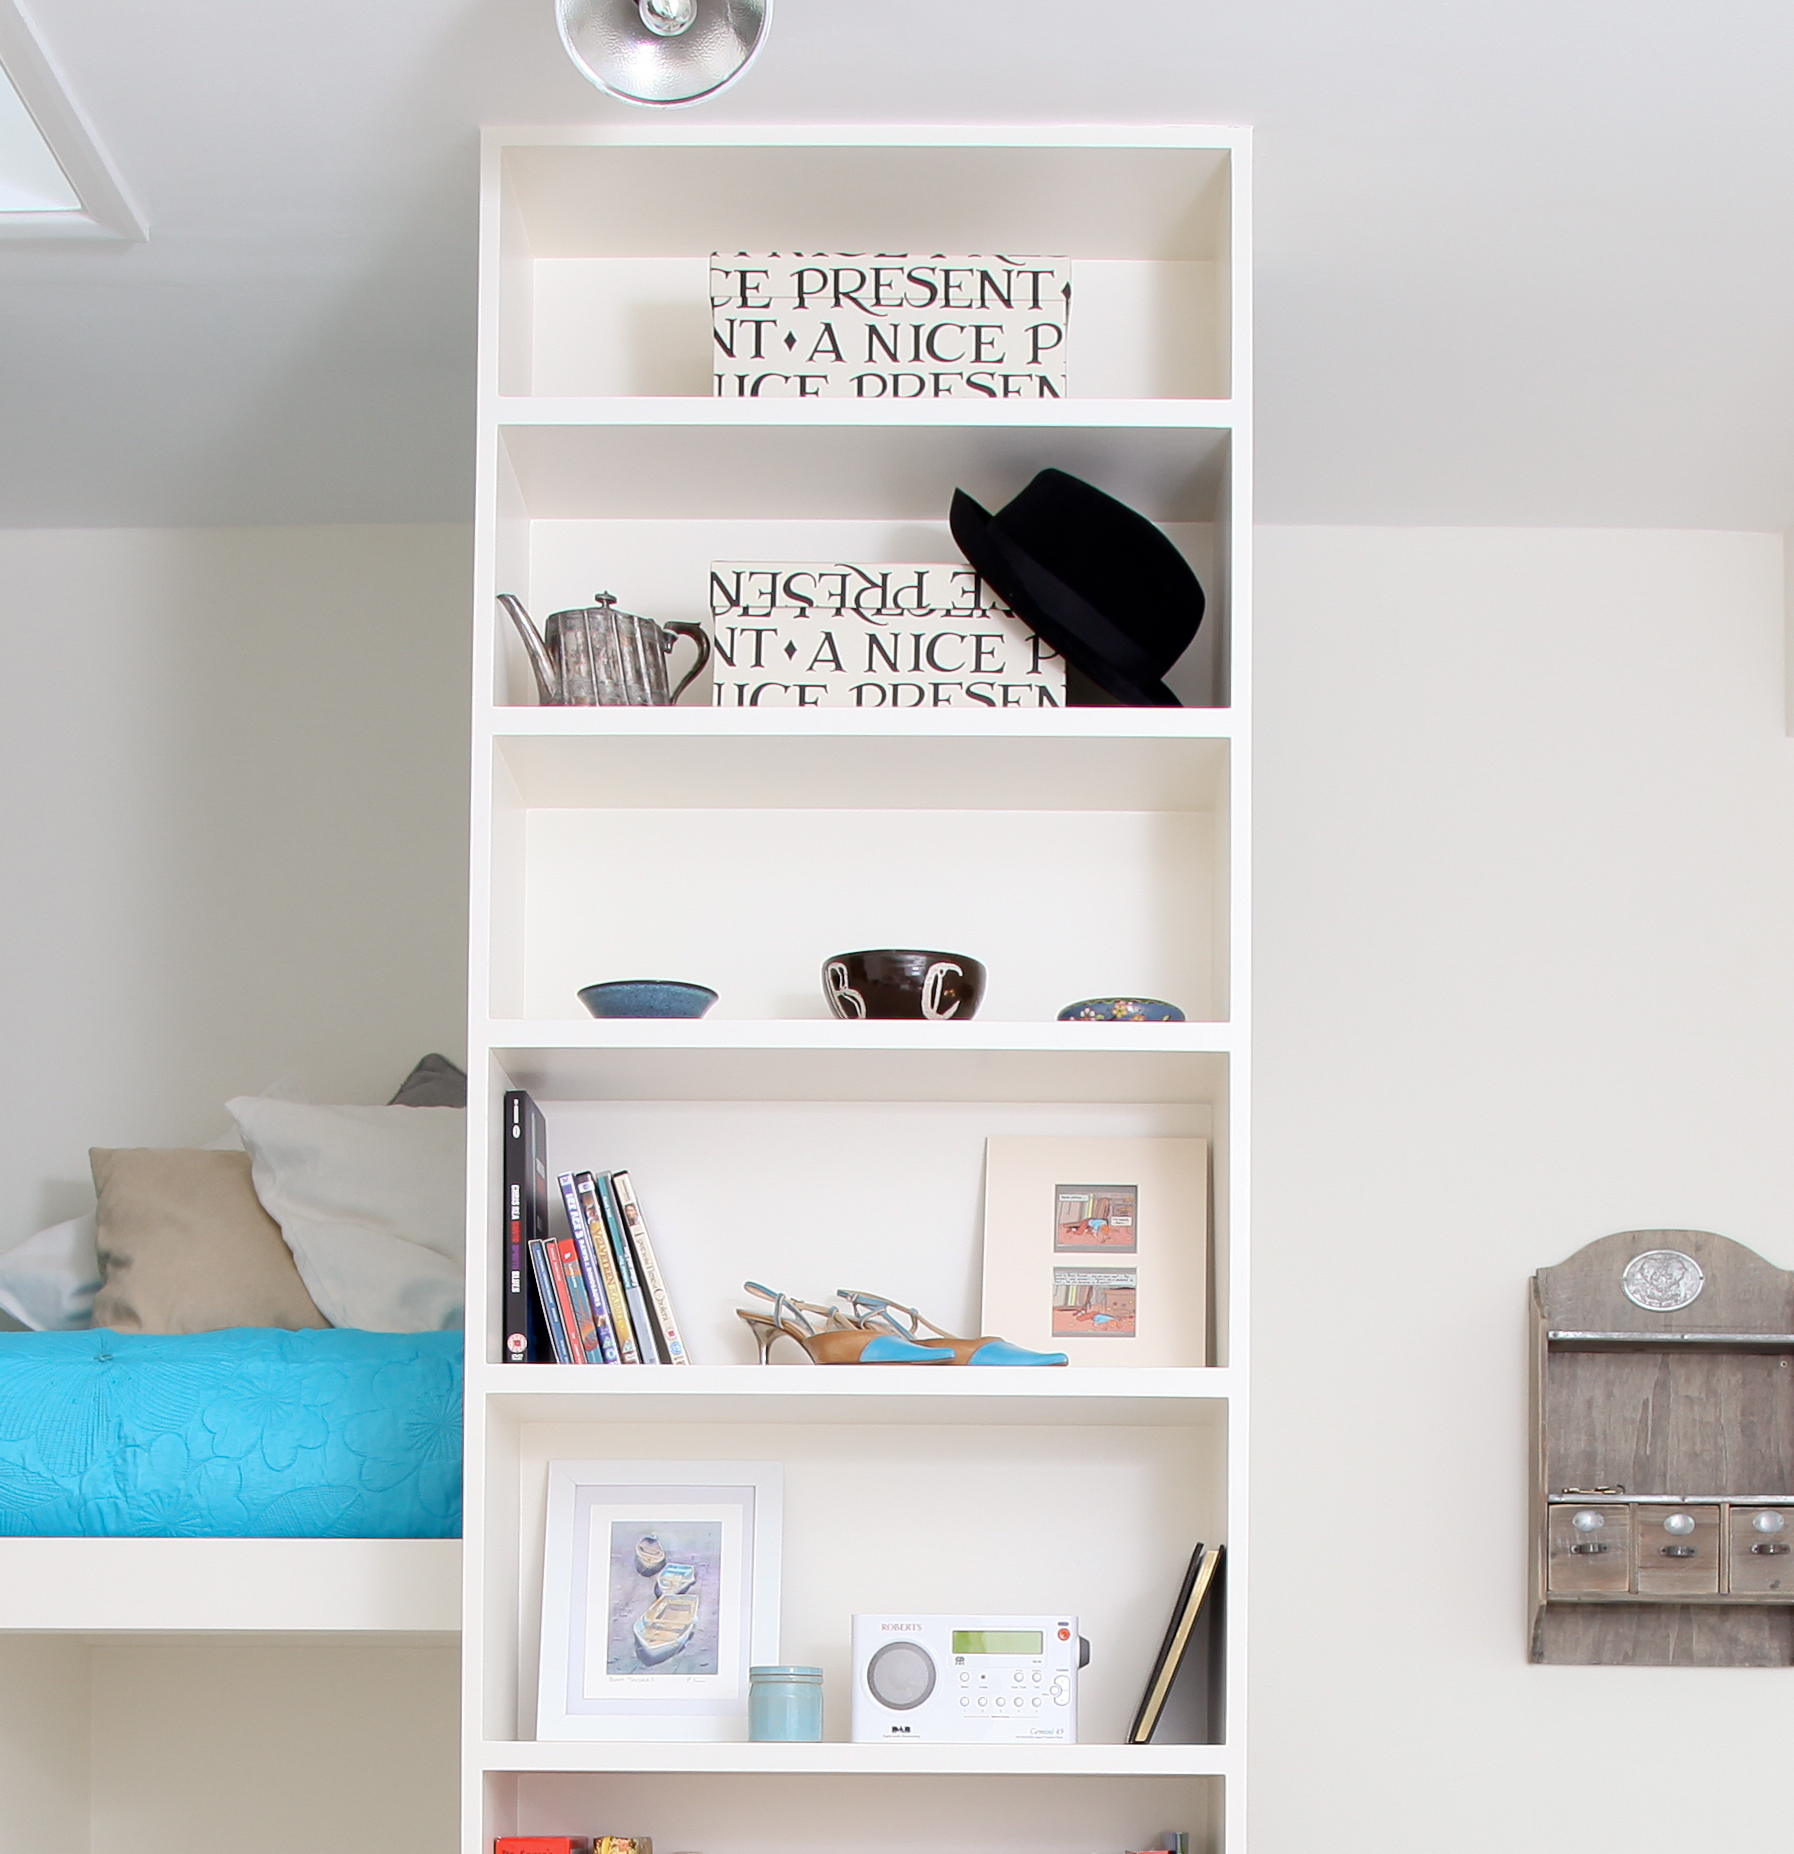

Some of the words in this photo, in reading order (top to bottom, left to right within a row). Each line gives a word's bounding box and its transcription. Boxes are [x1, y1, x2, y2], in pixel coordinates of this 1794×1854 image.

[789, 264, 1056, 318] PRESENT
[806, 321, 849, 363] A
[863, 322, 1007, 365] NICE
[806, 631, 849, 673] A
[863, 632, 1007, 674] NICE
[594, 1228, 614, 1286] VELVETEEN
[881, 1623, 924, 1631] ROBERTS
